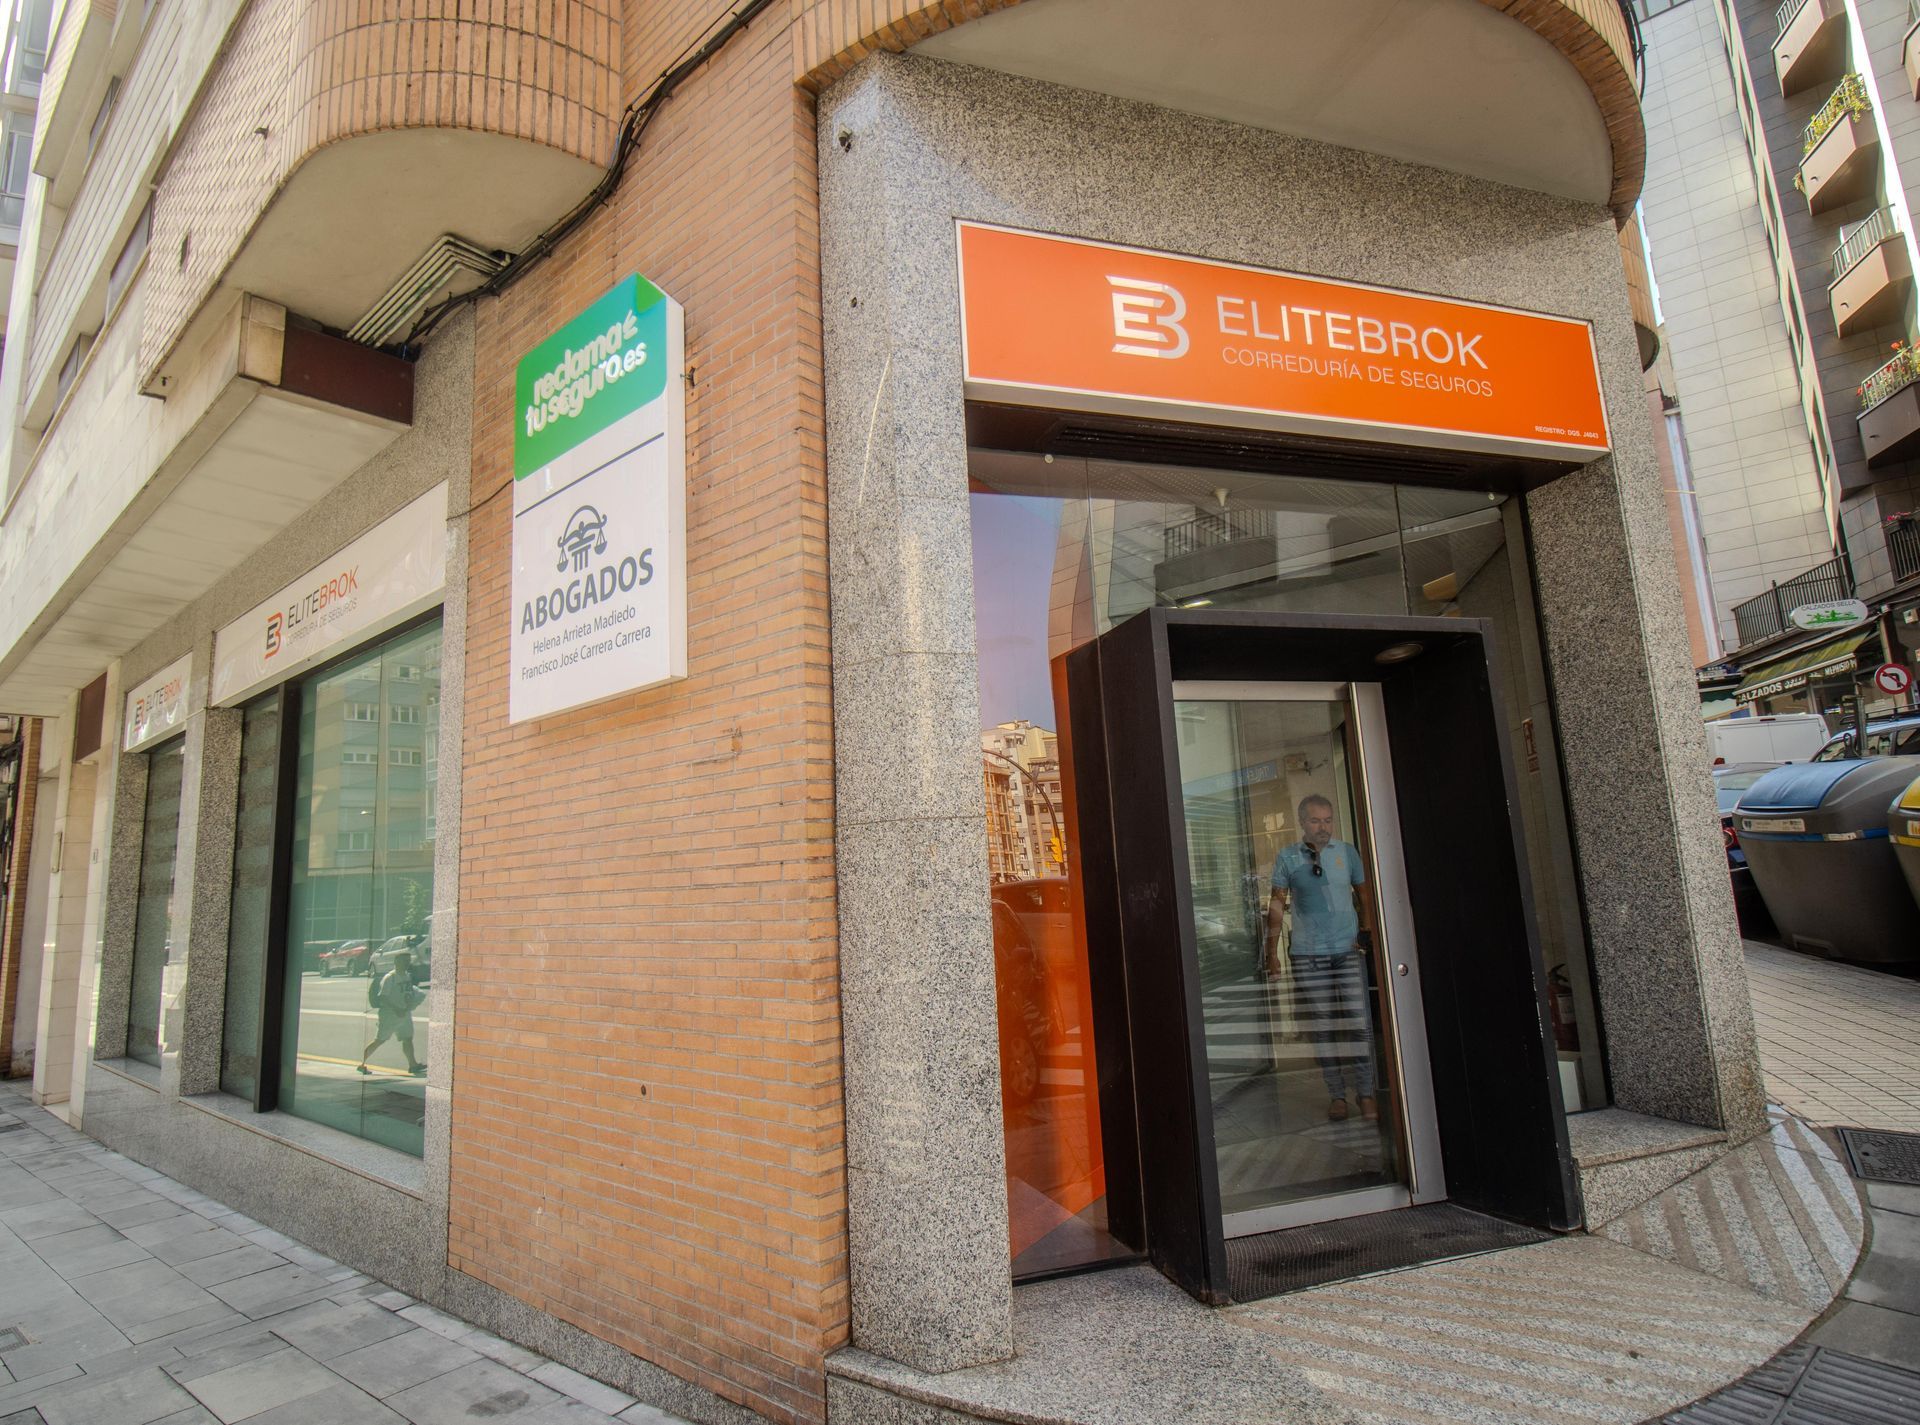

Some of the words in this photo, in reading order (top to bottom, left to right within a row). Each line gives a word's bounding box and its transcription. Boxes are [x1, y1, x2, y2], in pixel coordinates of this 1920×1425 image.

[1216, 296, 1489, 370] ELITEBROK
[534, 321, 622, 406] reclama
[1222, 347, 1363, 381] CORREDURÍA
[1368, 366, 1395, 385] DE
[1400, 370, 1493, 397] SEGUROS
[288, 565, 359, 629] ELITEBROK
[521, 548, 653, 635] ABOGADOS
[1801, 601, 1835, 611] CALZADOS
[1836, 600, 1857, 608] SELLA
[521, 659, 559, 680] Francisco
[560, 648, 579, 668] José
[580, 638, 613, 660] Carrera
[615, 625, 651, 648] Carrera
[533, 637, 560, 655] Helena
[562, 623, 592, 644] Arrieta
[594, 604, 636, 633] Madiedo
